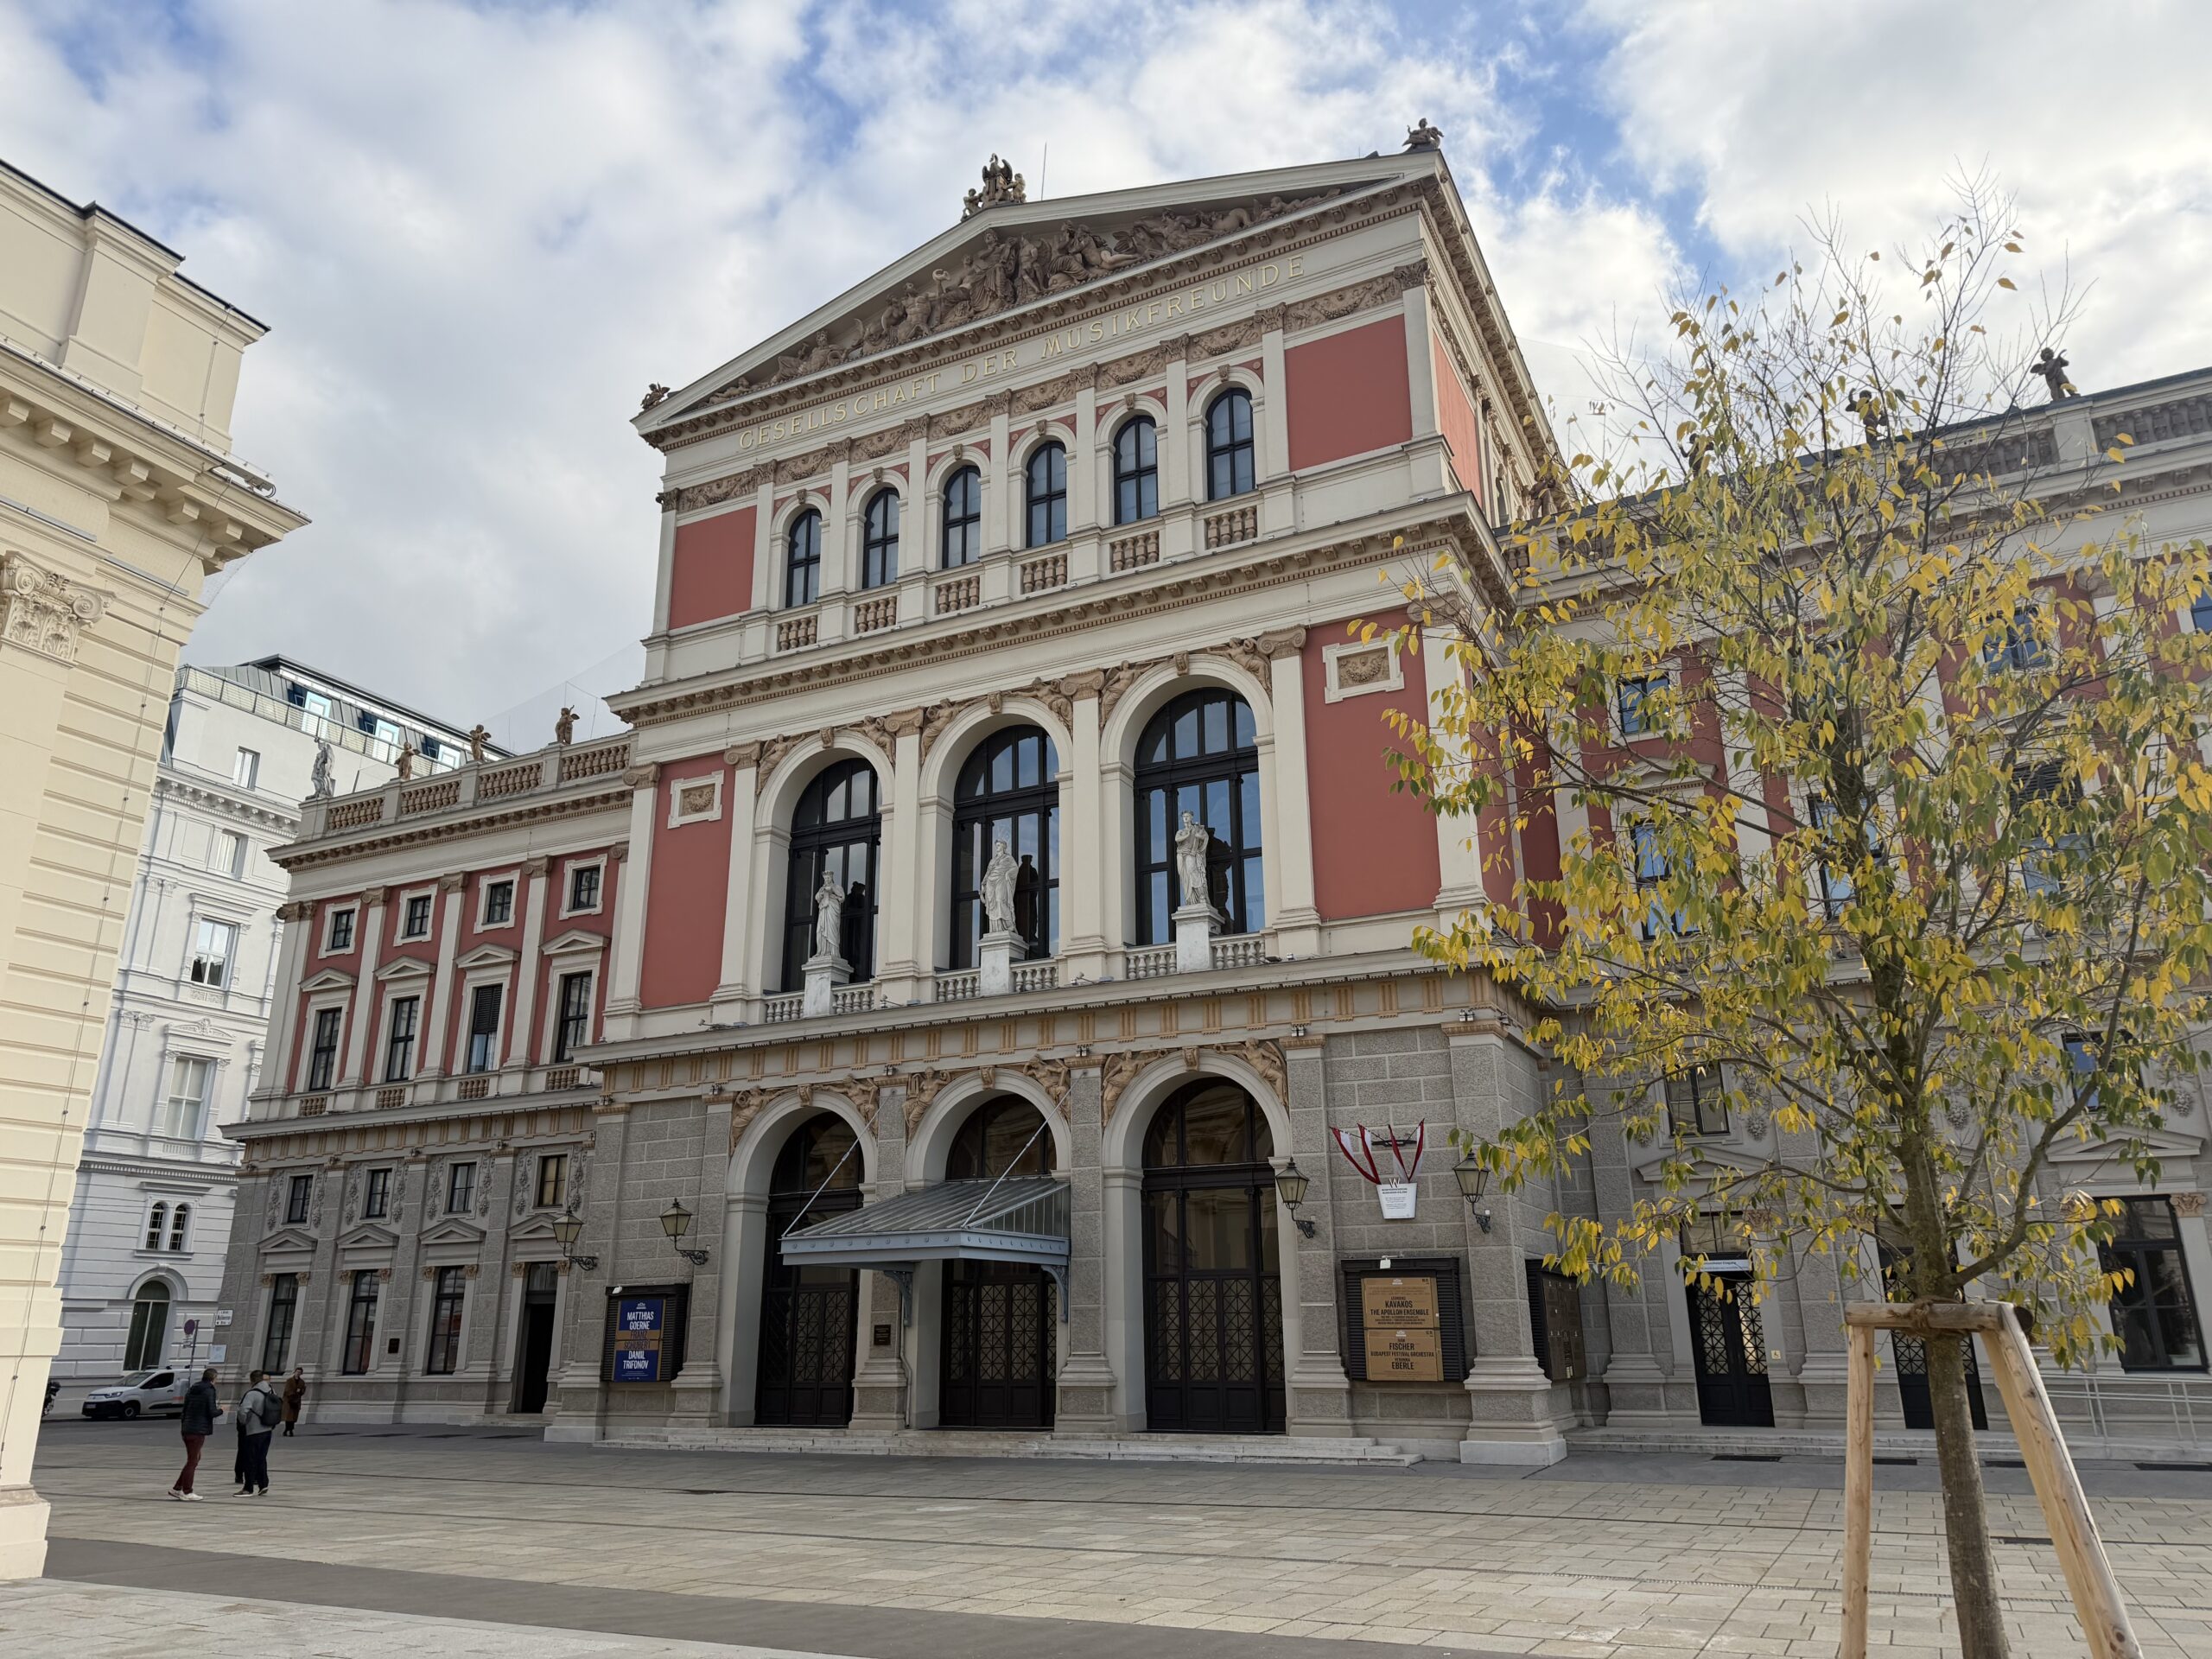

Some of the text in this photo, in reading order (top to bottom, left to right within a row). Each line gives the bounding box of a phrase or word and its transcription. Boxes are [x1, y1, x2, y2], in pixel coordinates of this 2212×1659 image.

[740, 255, 1305, 449] GESELLSCHAFT DER MUSIKFREUNDE
[626, 1311, 654, 1321] MATTHIAS
[629, 1321, 650, 1330] GOERNE
[623, 1360, 649, 1370] TRIFONOV
[1391, 1362, 1414, 1370] EBERLE
